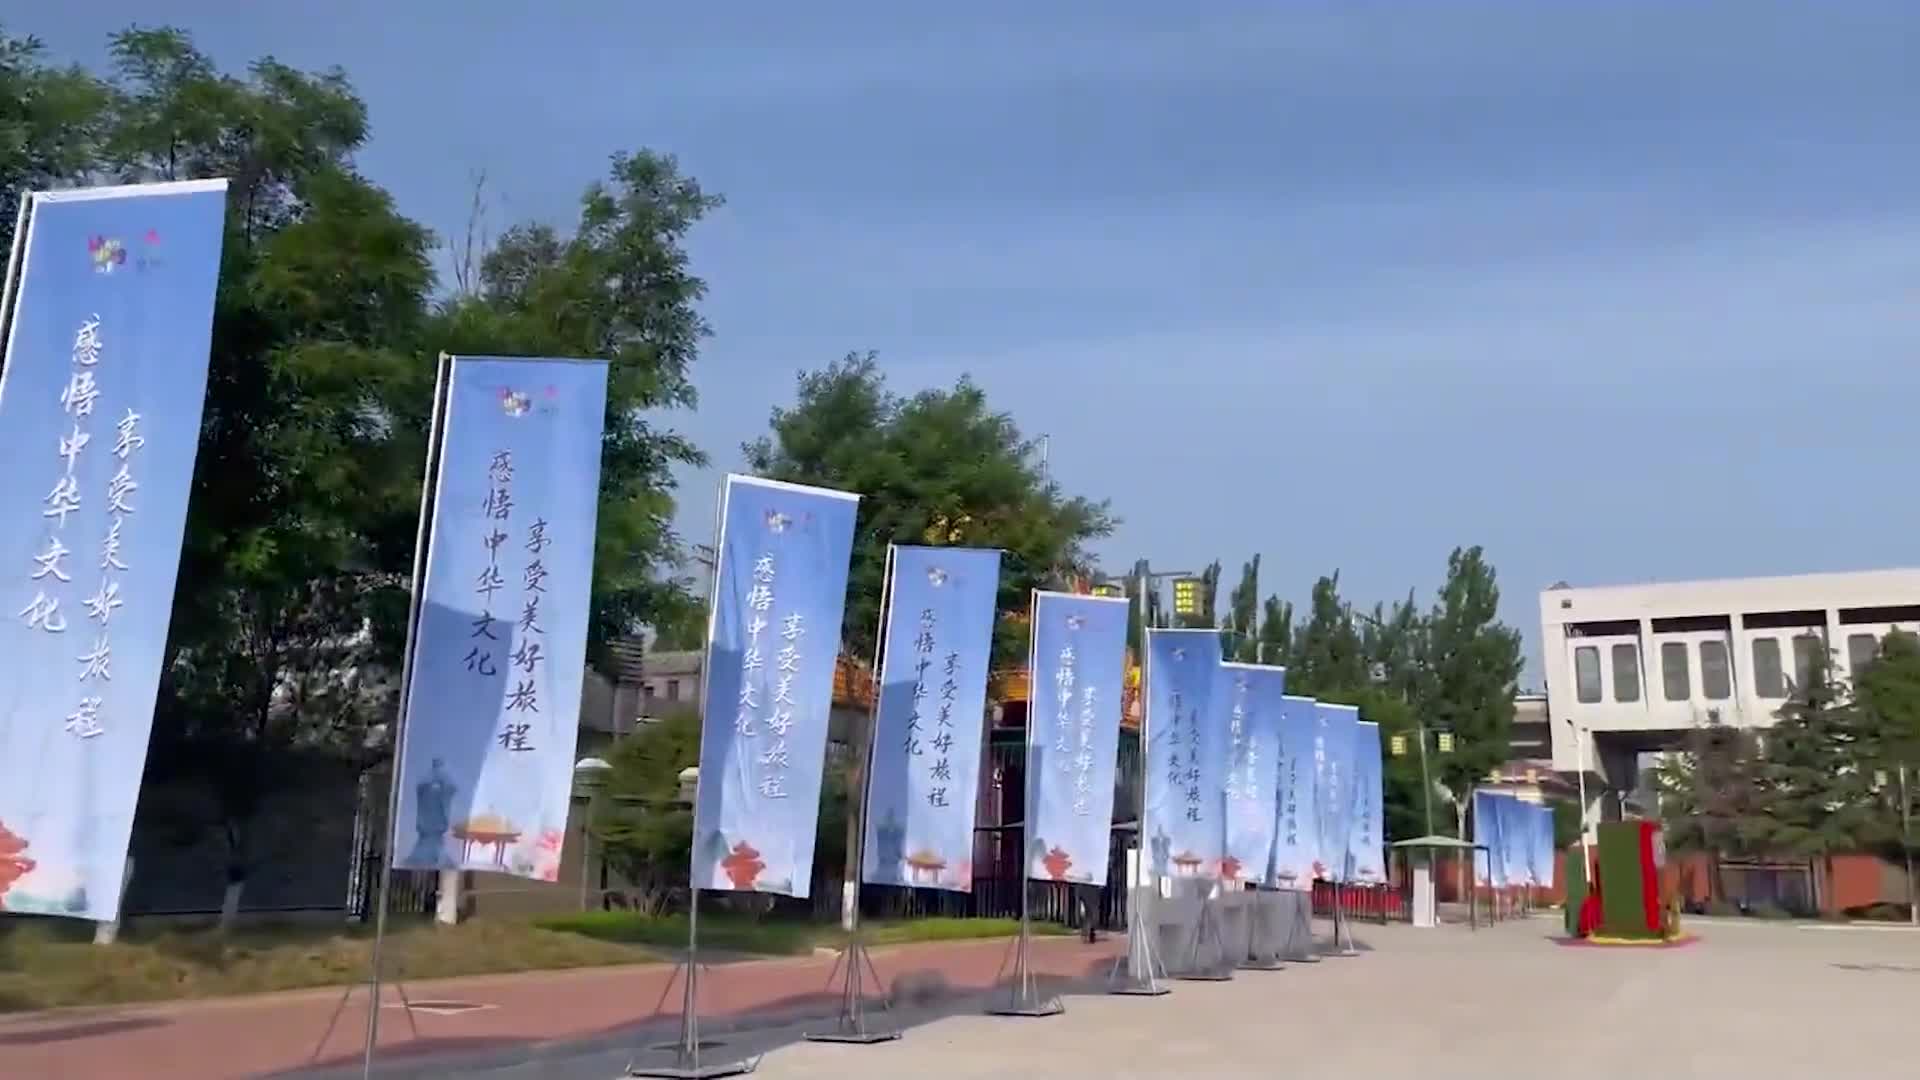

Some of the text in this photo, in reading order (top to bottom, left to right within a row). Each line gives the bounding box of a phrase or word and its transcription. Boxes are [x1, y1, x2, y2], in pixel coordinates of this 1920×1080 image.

[18, 312, 104, 633] 感悟中华文化
[65, 406, 146, 738] 享受美好旅程
[462, 450, 515, 676] 感悟中华文化
[497, 517, 553, 752] 享受美好旅程
[734, 552, 775, 736] 感悟中华文化
[758, 613, 806, 798] 享受美好旅程
[903, 608, 936, 756] 感悟中华文化
[927, 652, 960, 807] 享受美好旅程
